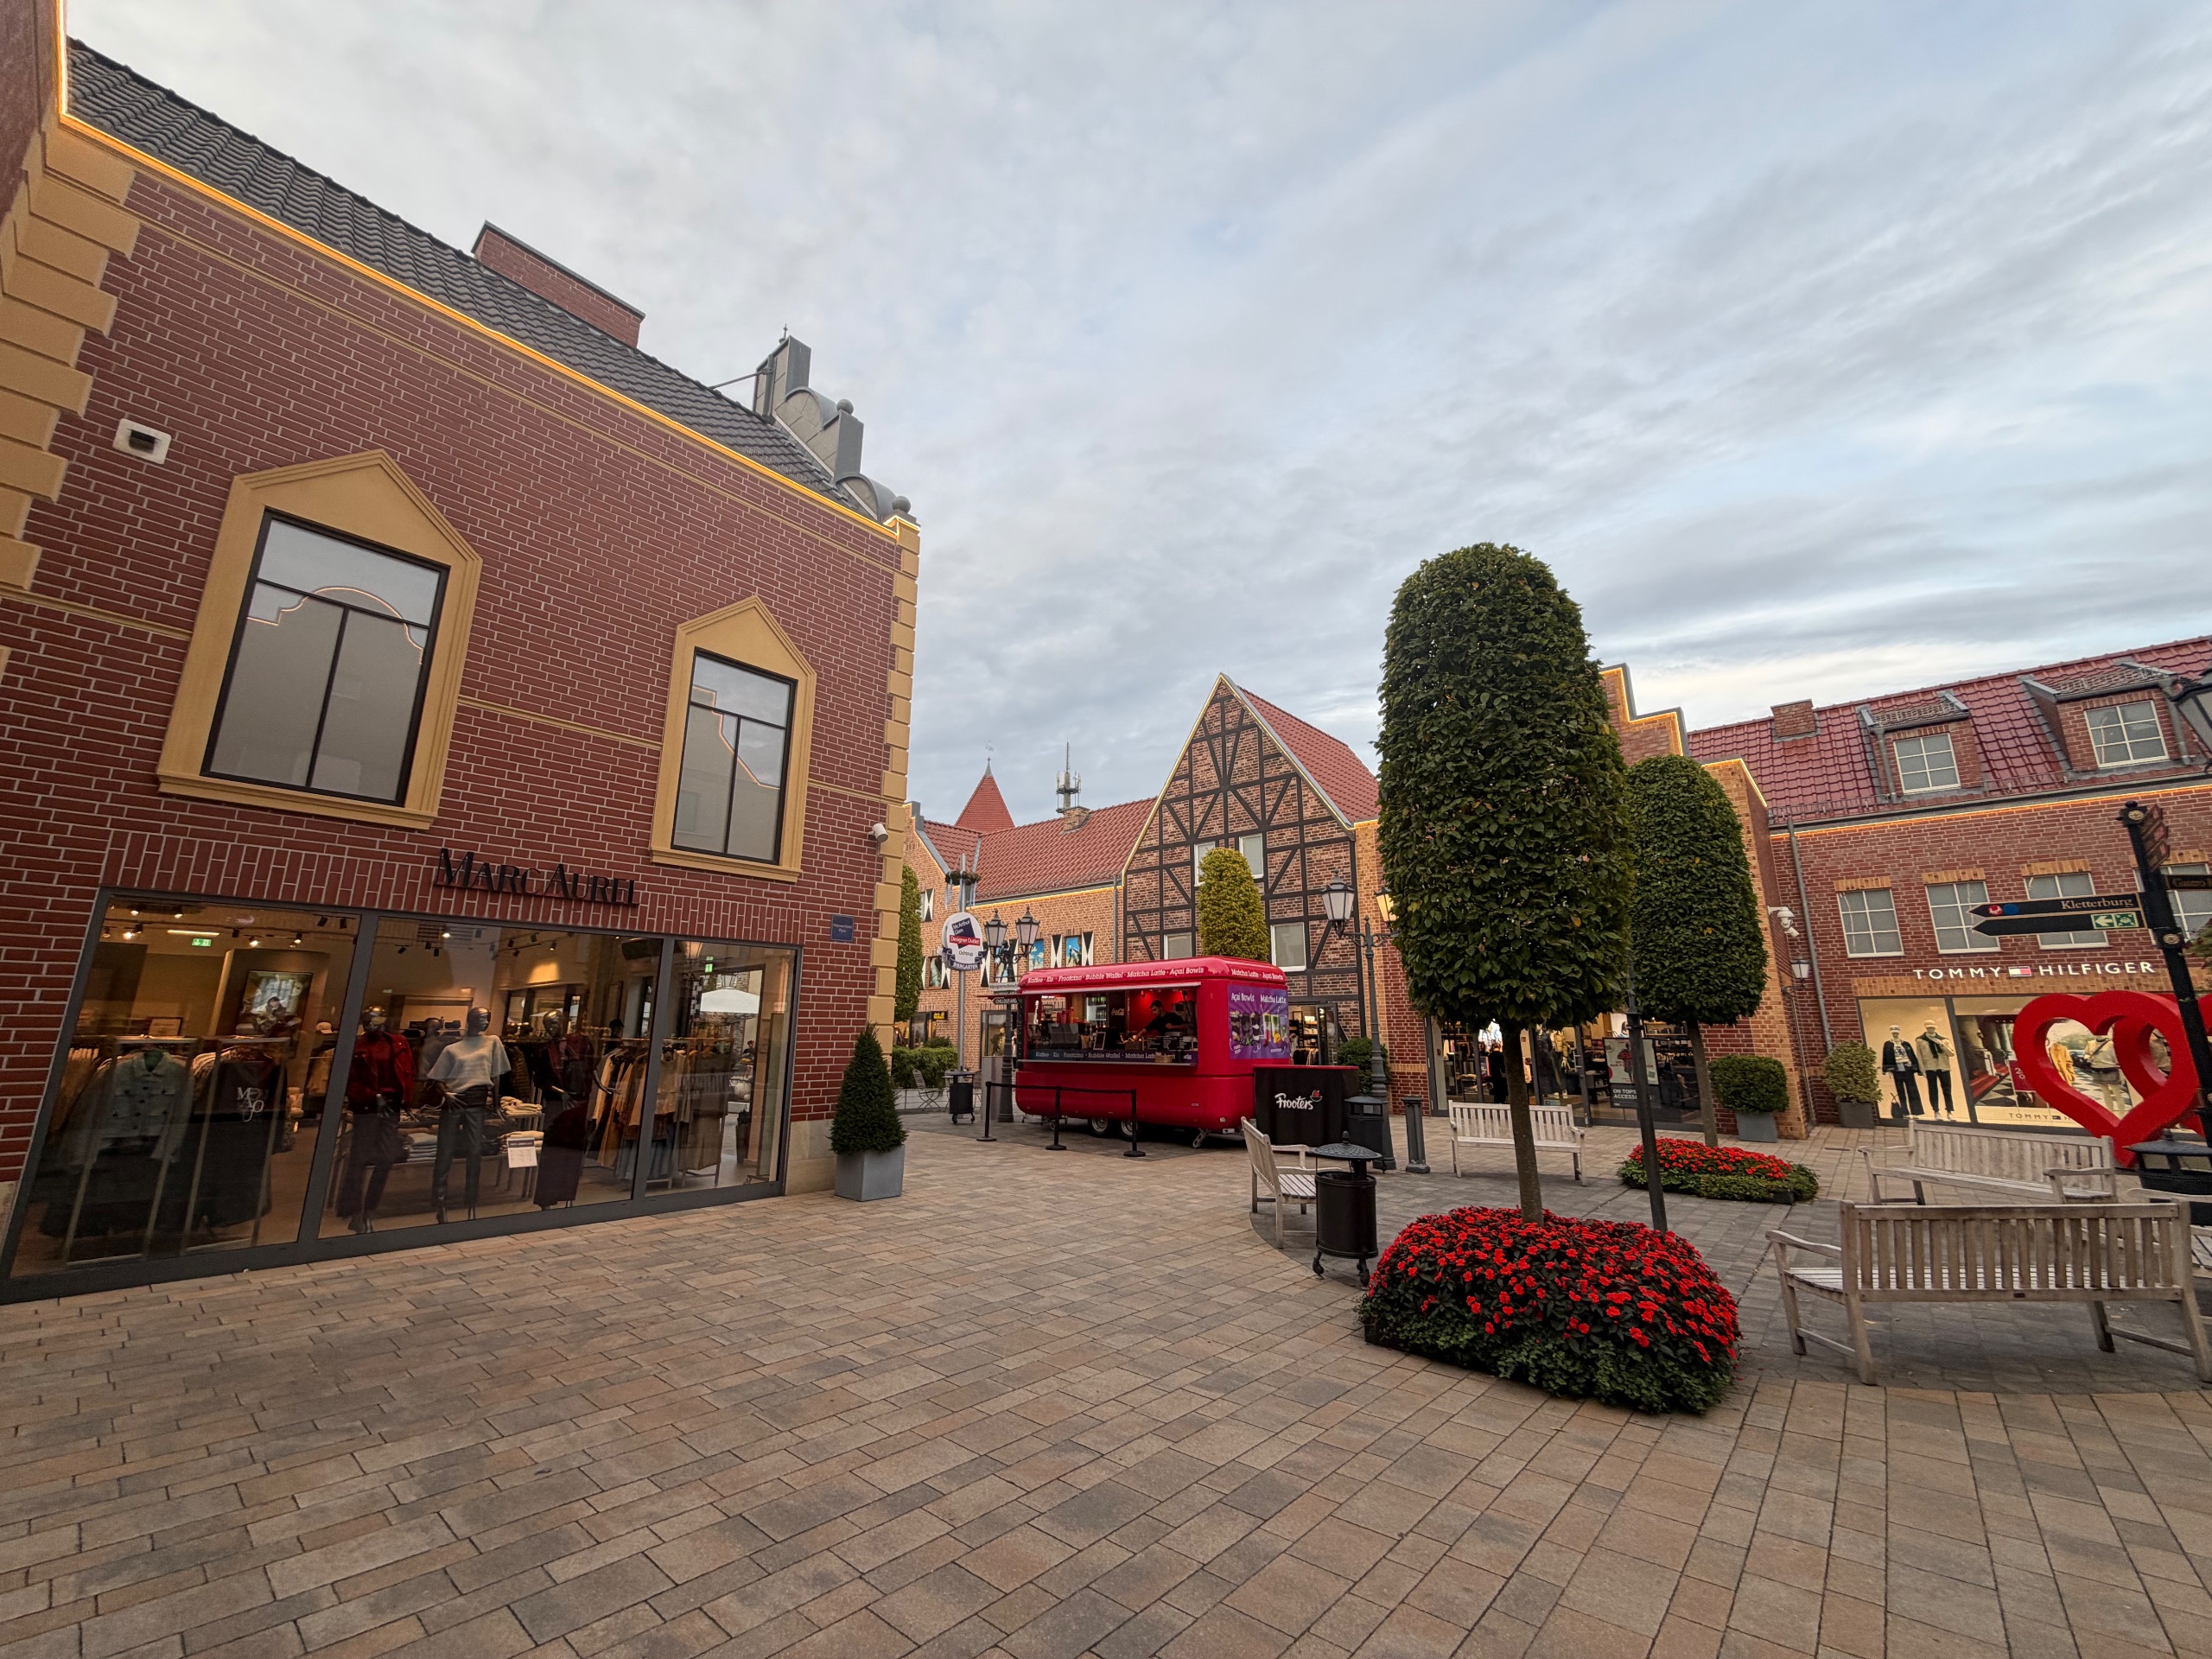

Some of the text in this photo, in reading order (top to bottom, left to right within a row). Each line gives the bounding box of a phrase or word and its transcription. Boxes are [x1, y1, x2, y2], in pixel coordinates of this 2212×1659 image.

[434, 848, 636, 906] MARC AUREL
[2061, 898, 2134, 910] Kletterburg
[1185, 966, 1205, 975] Bowls
[1231, 968, 1248, 976] Matcha
[1913, 962, 2157, 980] TOMMY HILFIGER
[1241, 993, 1255, 1002] Bowls
[1260, 995, 1287, 1004] Matcha Latte
[1274, 1092, 1313, 1110] Frooters
